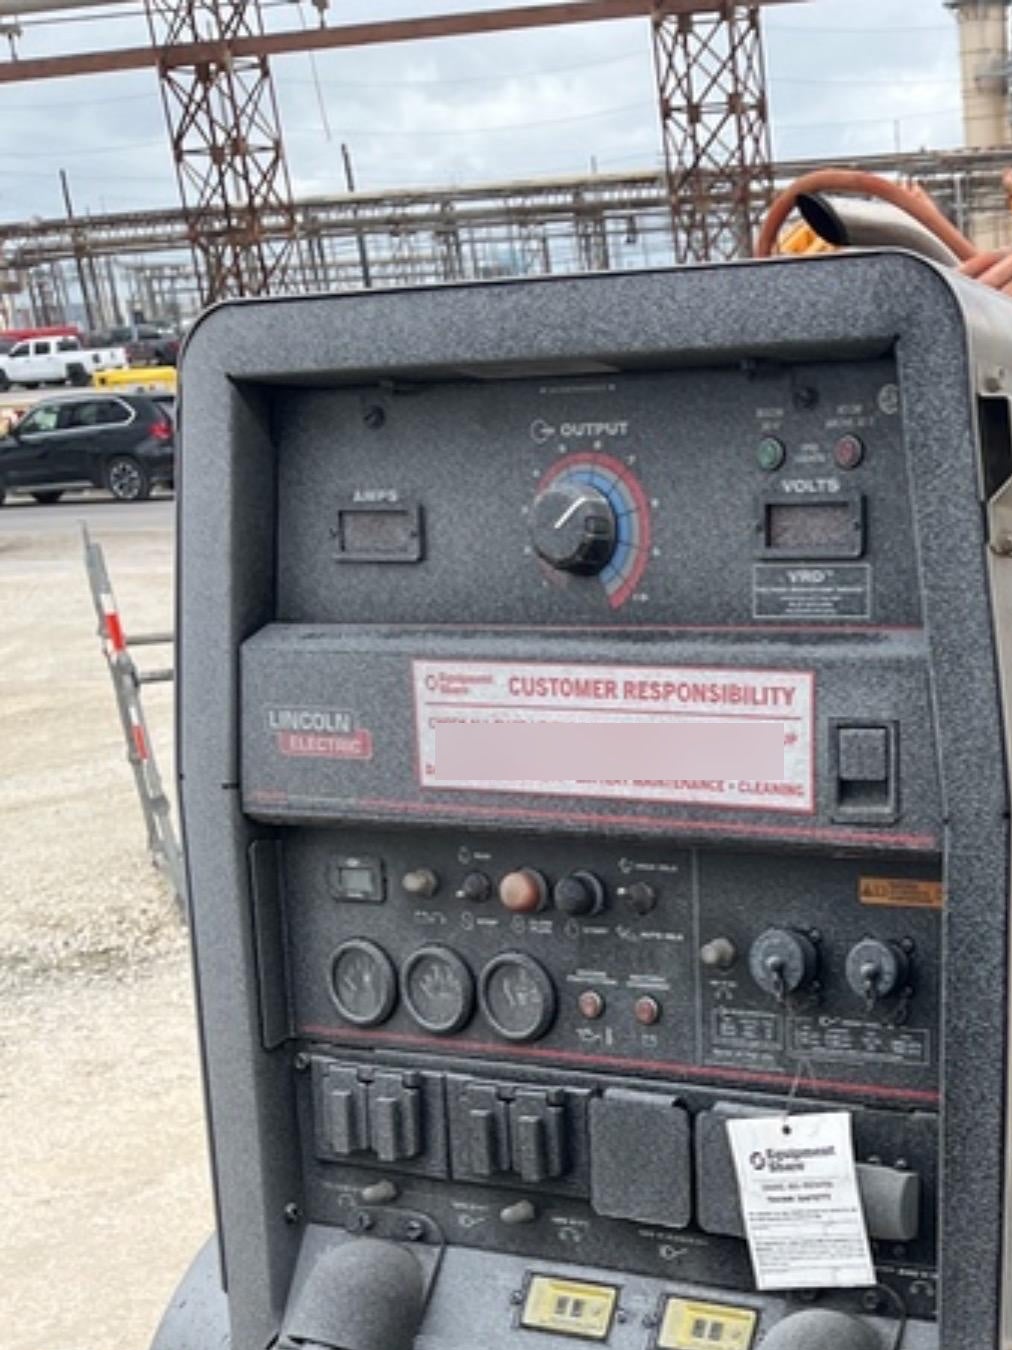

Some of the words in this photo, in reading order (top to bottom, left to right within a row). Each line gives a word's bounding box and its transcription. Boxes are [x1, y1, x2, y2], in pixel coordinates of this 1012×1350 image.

[560, 422, 628, 436] OUTPUT
[781, 479, 840, 493] VOLTS
[353, 489, 398, 503] AMPS
[508, 676, 618, 699] CUSTOMER
[623, 680, 797, 706] RESPONSIBILITY
[268, 709, 351, 732] LINCOLN
[288, 735, 363, 754] ELECTRIC
